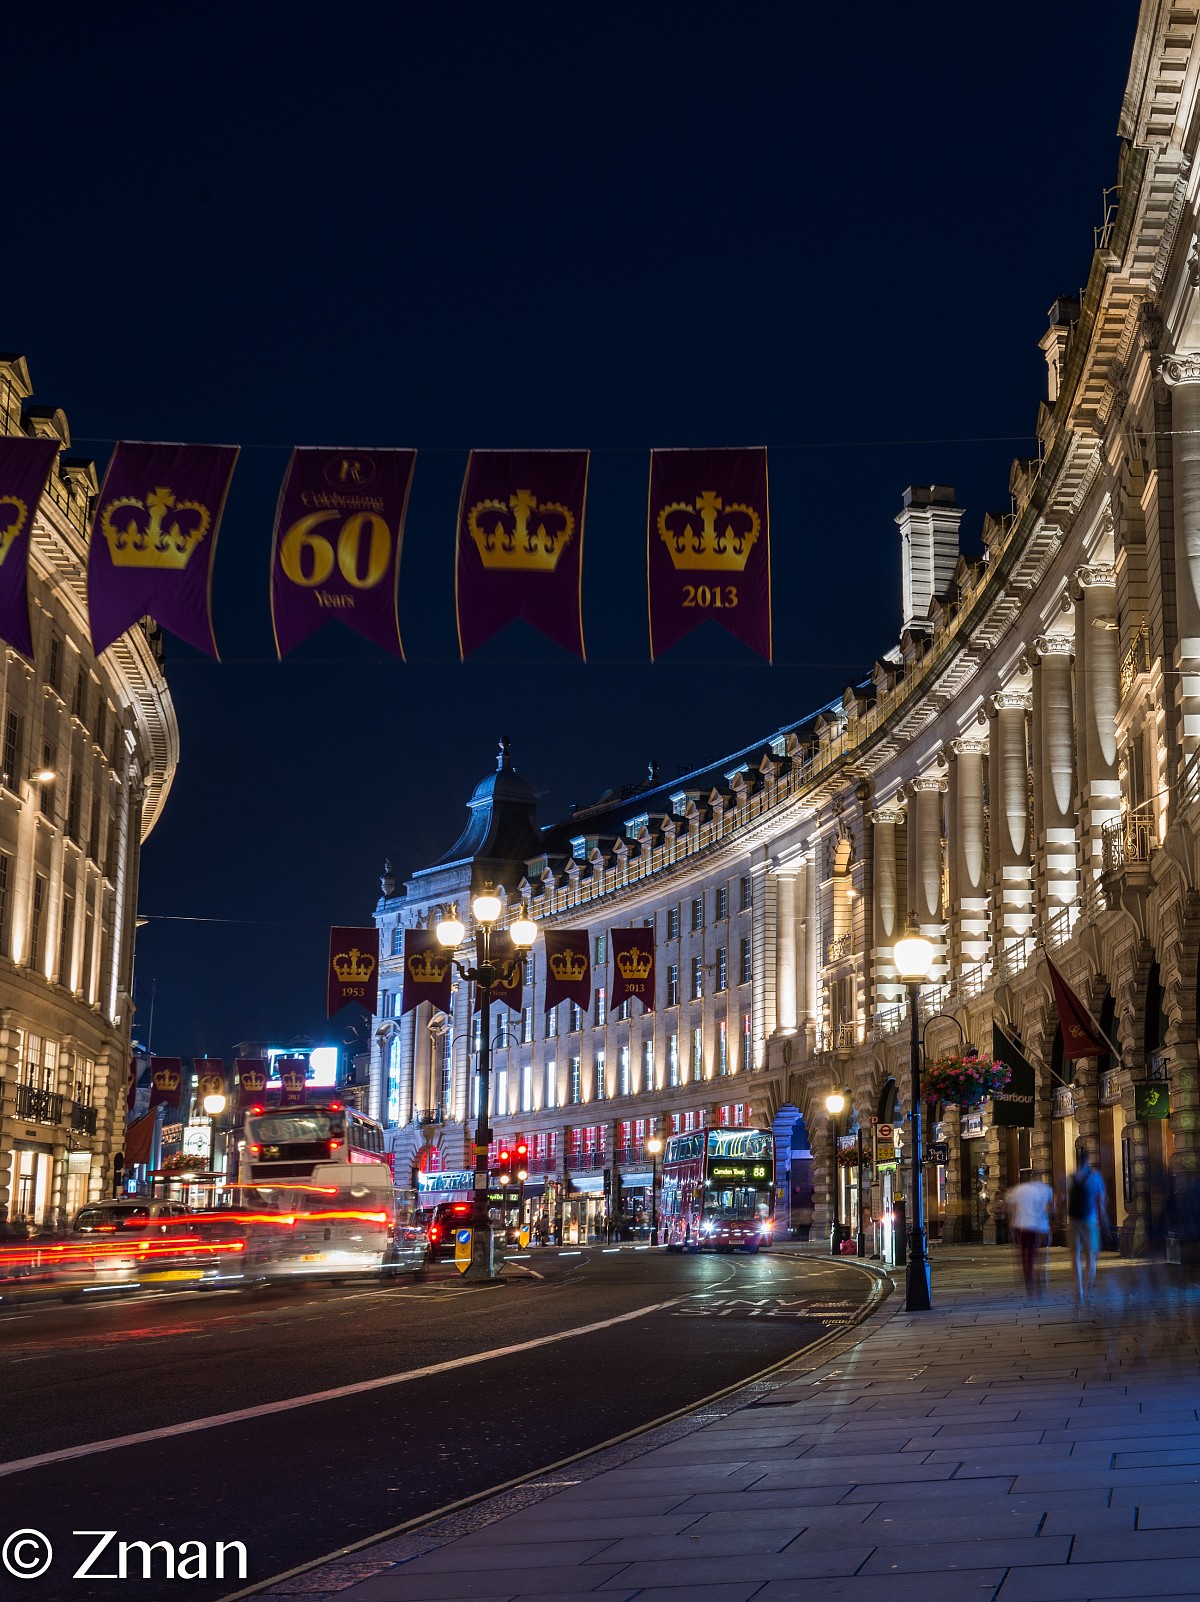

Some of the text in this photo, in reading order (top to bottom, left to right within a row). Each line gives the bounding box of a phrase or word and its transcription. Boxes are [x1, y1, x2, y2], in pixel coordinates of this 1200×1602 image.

[281, 509, 392, 589] 60
[314, 589, 355, 609] Years
[681, 584, 739, 608] 2013
[341, 987, 365, 997] 1953
[624, 983, 645, 992] 2013
[996, 1092, 1034, 1104] Barbour
[733, 1168, 746, 1176] Town
[753, 1167, 765, 1177] 88
